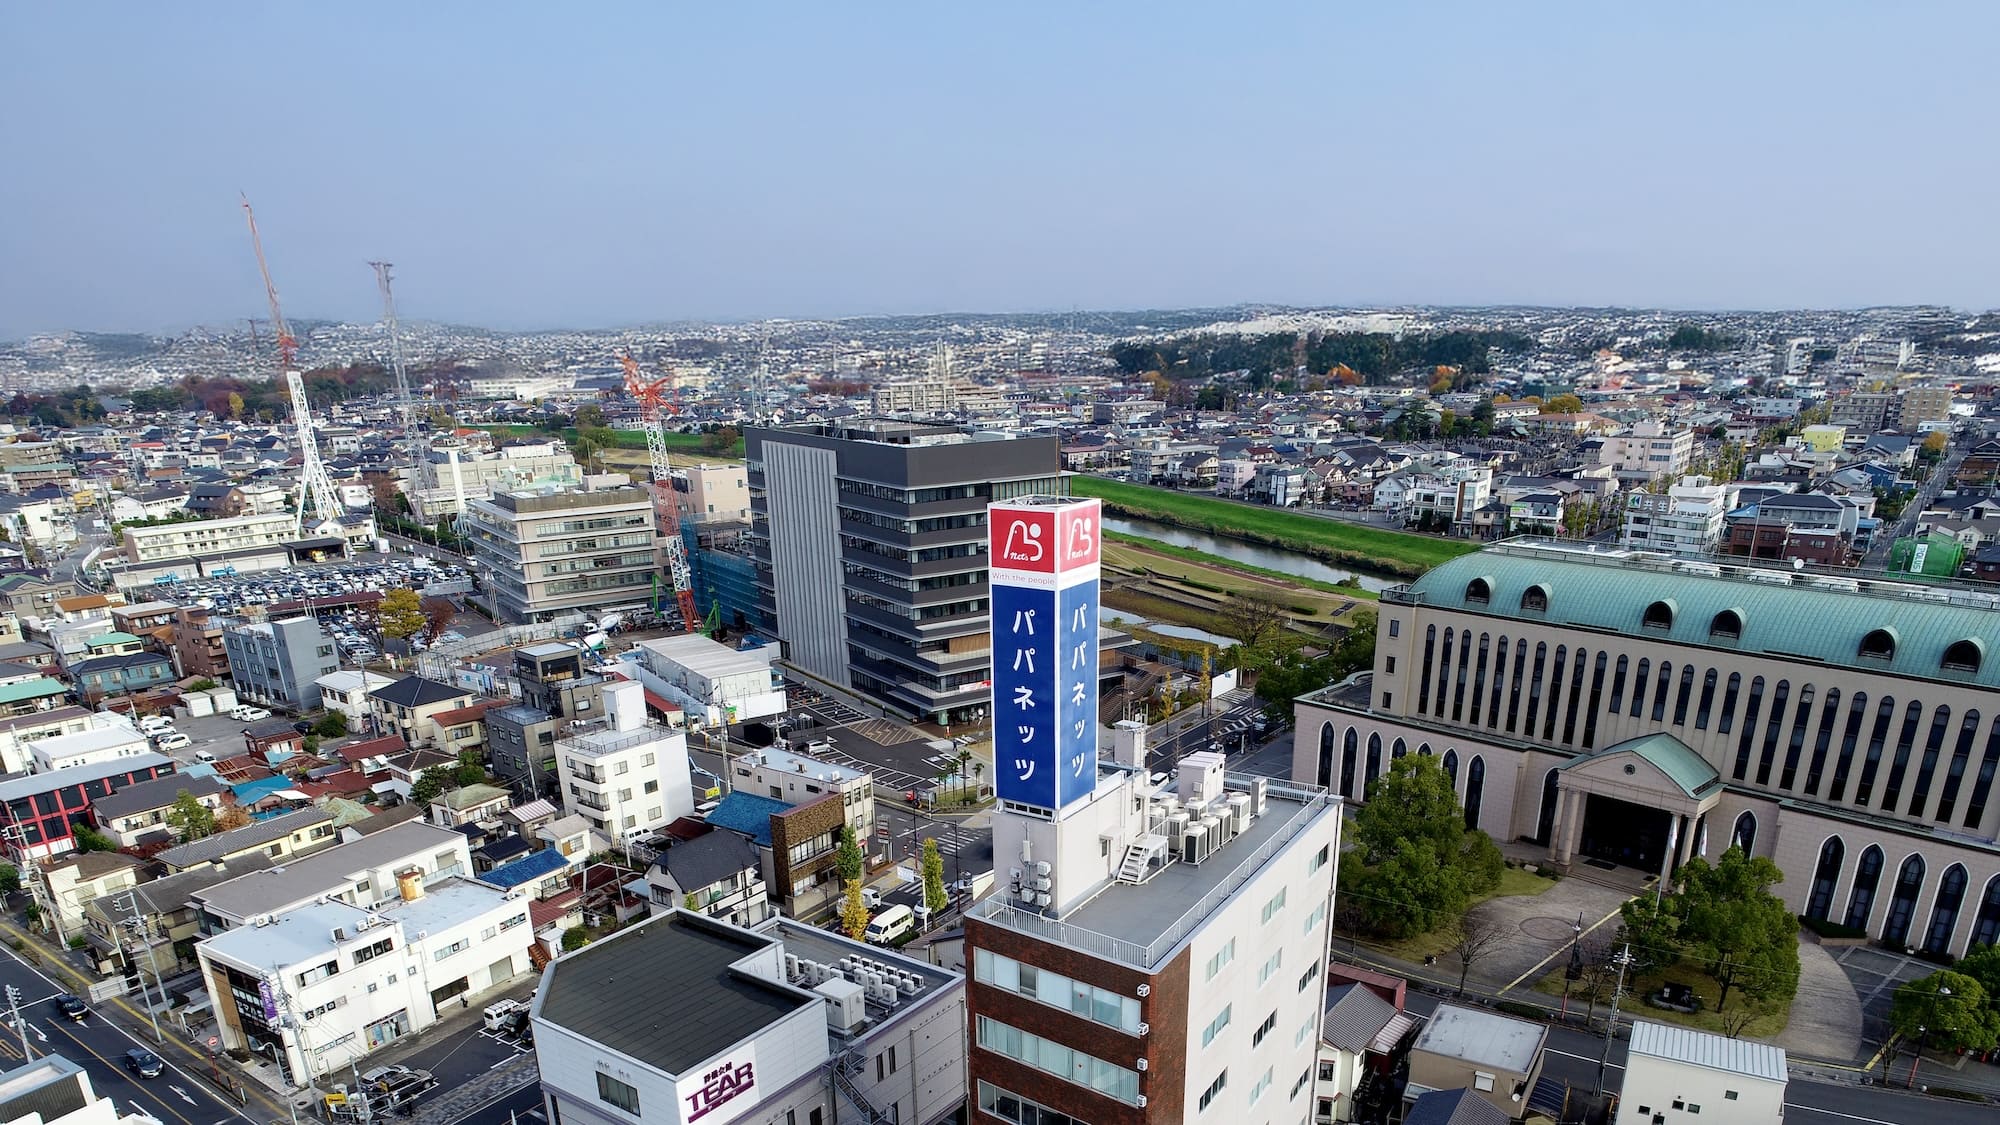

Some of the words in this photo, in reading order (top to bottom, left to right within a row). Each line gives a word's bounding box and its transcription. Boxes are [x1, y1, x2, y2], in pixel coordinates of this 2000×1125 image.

[992, 572, 1009, 580] With
[1028, 577, 1055, 585] people
[1913, 546, 1926, 569] POLUS
[1013, 609, 1036, 781] パパネッツ
[1072, 603, 1087, 778] パパネッツ
[685, 1062, 754, 1112] TEAR
